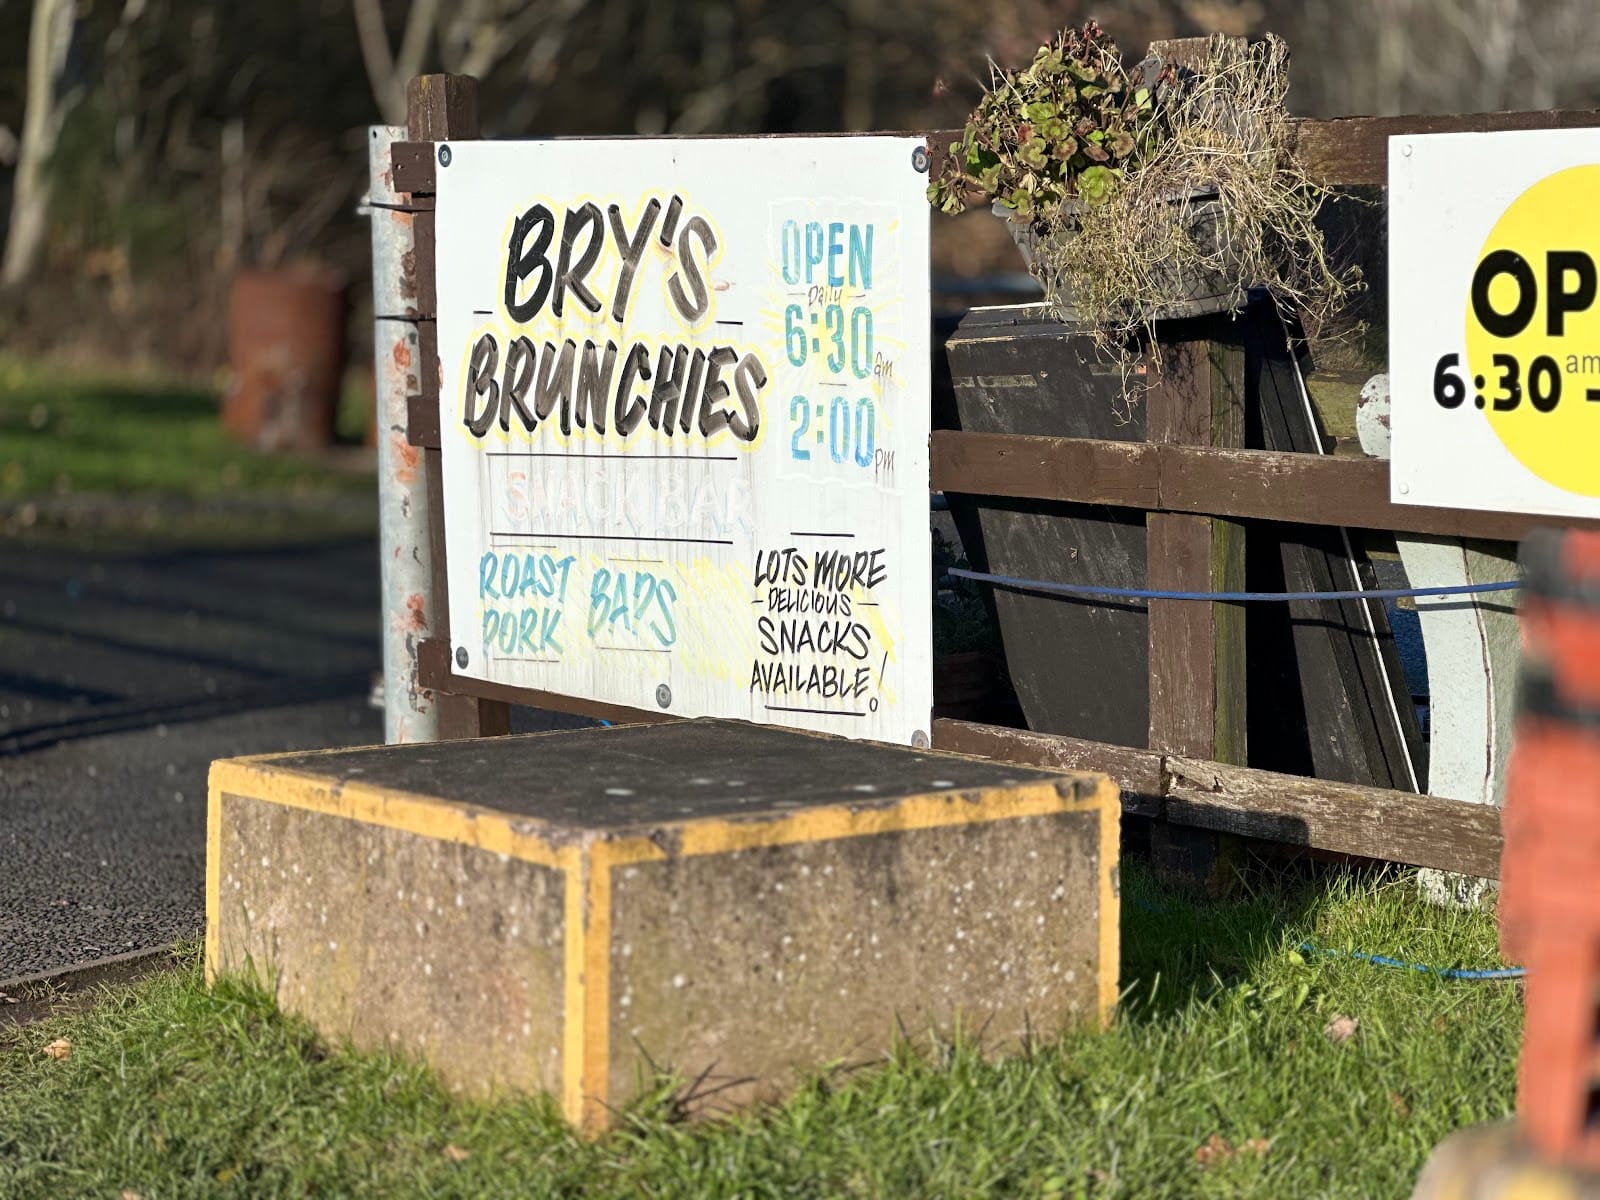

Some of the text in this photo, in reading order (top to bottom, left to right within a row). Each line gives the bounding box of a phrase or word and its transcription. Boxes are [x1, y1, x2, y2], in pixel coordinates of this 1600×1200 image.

[504, 194, 718, 323] BRY'S
[781, 218, 874, 289] OPEN
[1471, 249, 1598, 338] OP
[785, 304, 873, 380] 6:30
[463, 333, 767, 441] BRUNCHIES
[1433, 352, 1562, 413] 6:30
[790, 395, 875, 467] 2:00
[479, 551, 577, 601] ROAST
[754, 548, 888, 592] LOTS MORE
[768, 587, 852, 617] DELICIOUS
[482, 607, 564, 657] PORK
[758, 616, 871, 660] SNACKS
